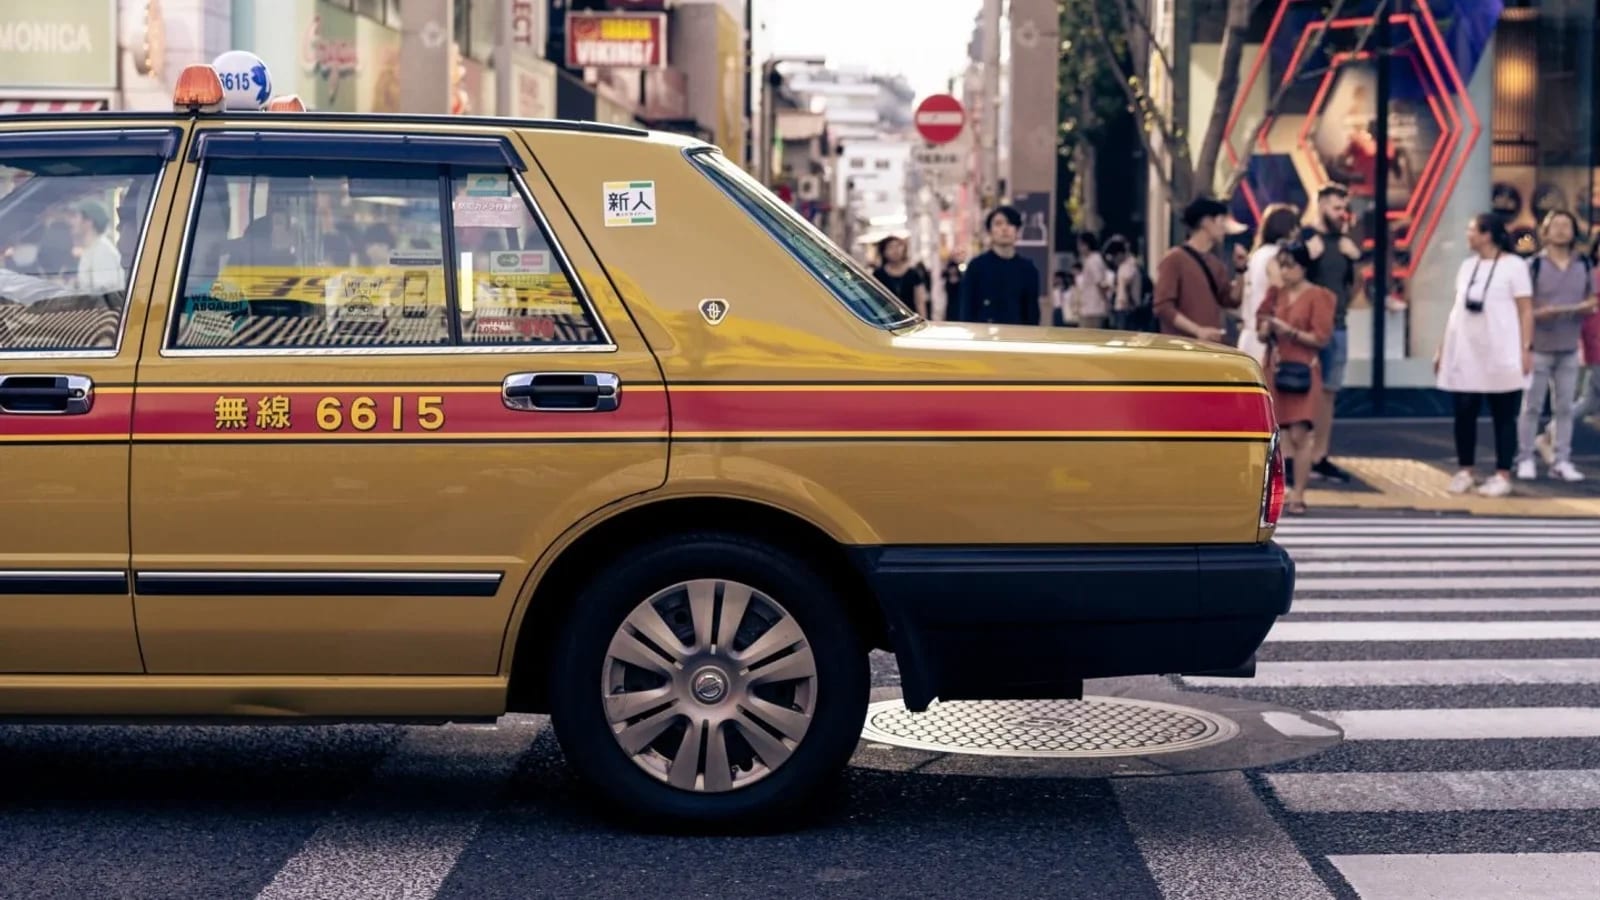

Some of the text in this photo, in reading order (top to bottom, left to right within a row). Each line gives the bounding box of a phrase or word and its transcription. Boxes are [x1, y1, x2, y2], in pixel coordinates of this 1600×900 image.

[0, 22, 93, 53] MONICA
[511, 0, 532, 46] ECT
[608, 191, 652, 211] 新人
[215, 395, 445, 430] 無線 6615
